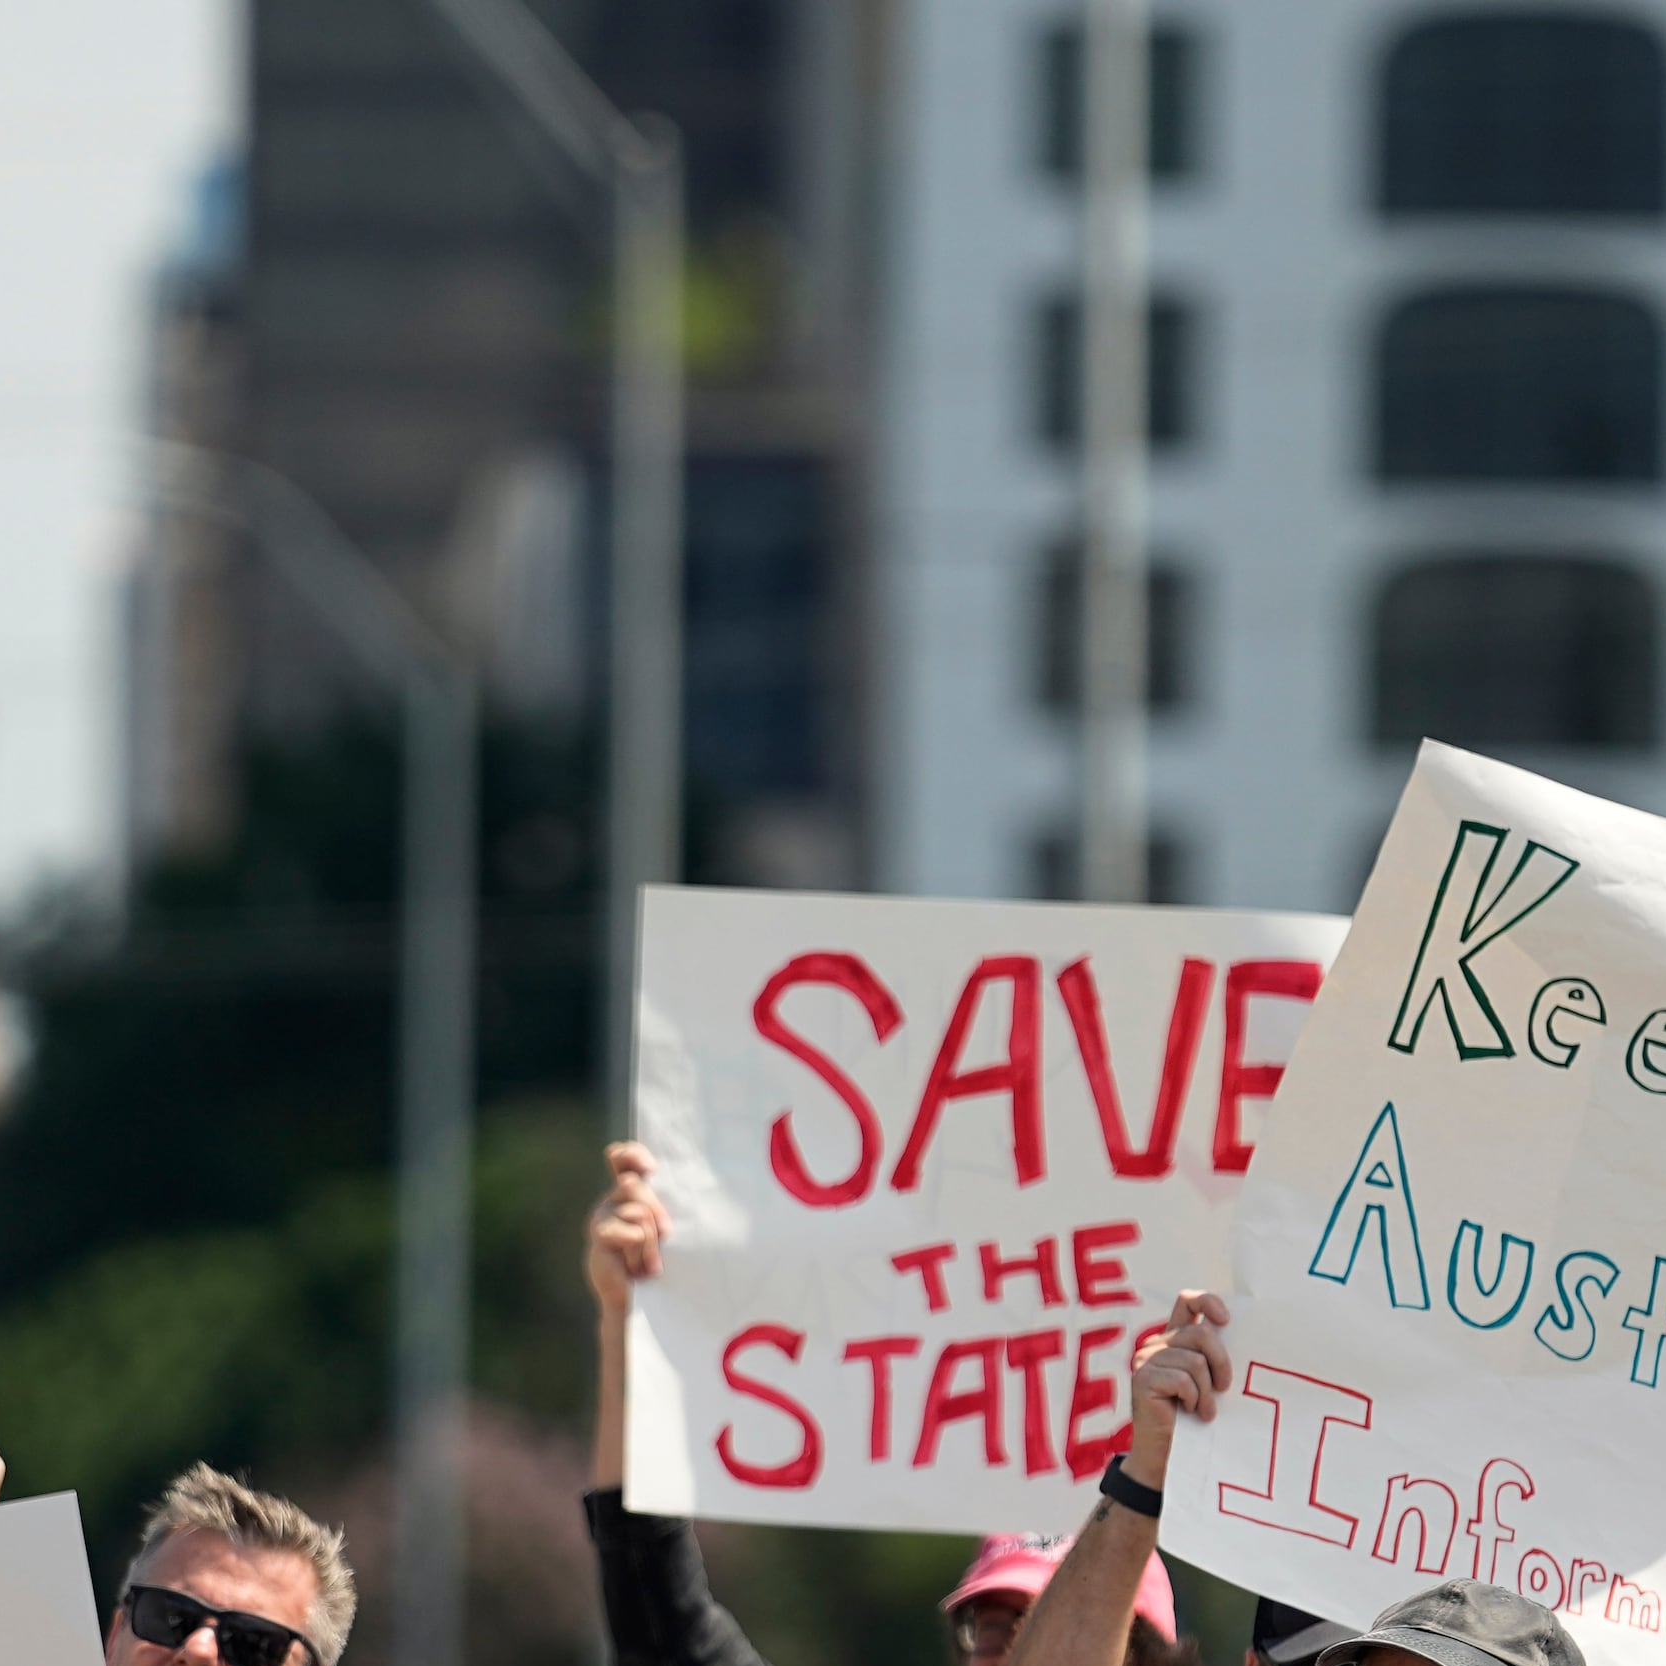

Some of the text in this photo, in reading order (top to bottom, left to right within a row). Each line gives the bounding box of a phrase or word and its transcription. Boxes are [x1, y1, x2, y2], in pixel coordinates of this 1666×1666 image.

[751, 950, 1325, 1211] SAVE
[890, 1221, 1141, 1313] THE
[715, 1322, 1167, 1490] STATE
